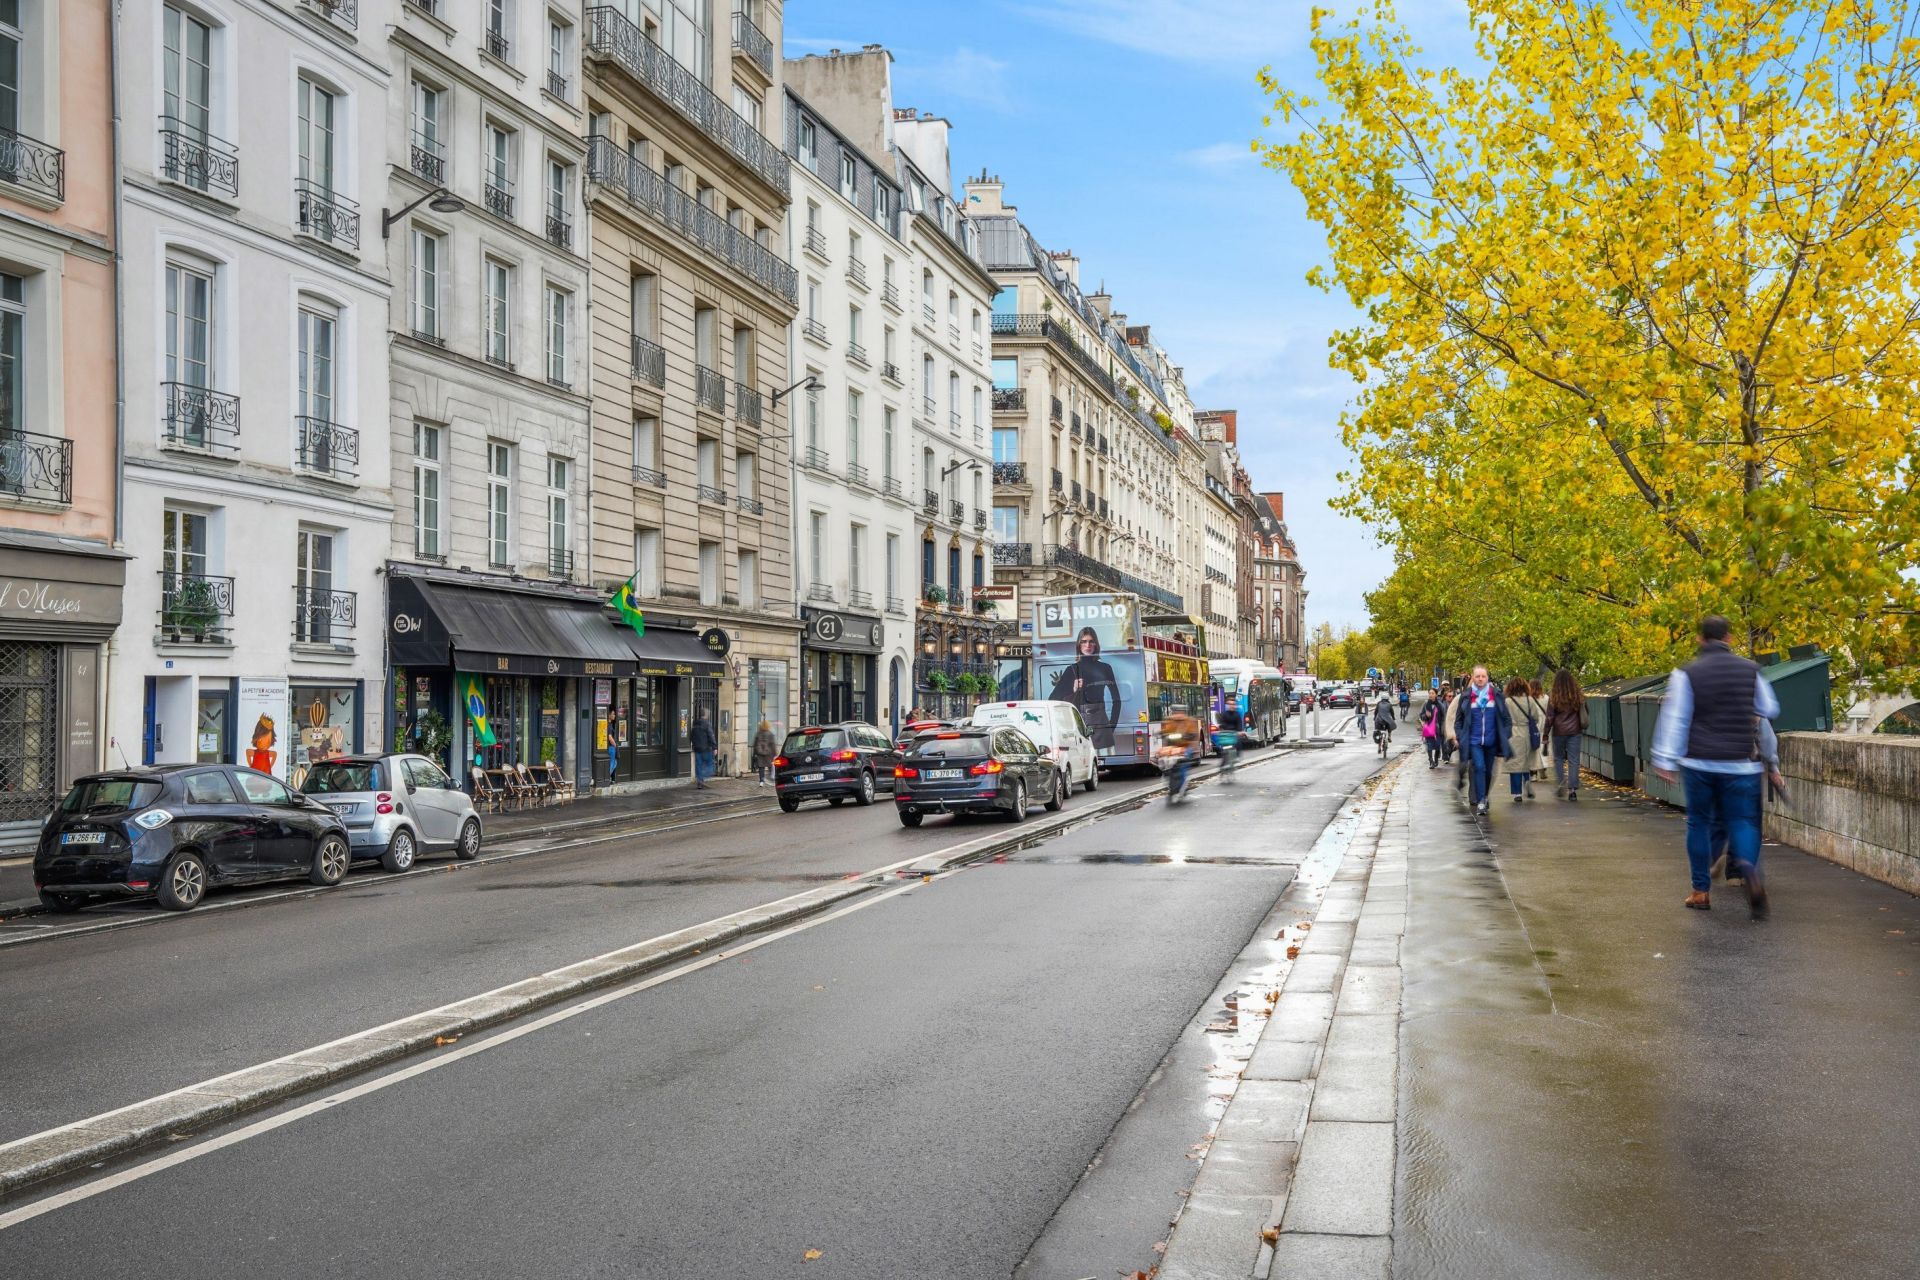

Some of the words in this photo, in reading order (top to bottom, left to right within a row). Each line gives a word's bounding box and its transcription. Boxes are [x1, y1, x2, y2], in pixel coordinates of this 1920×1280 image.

[17, 582, 81, 613] Muses
[1046, 603, 1127, 621] SANDRO
[822, 621, 836, 634] 21
[497, 657, 509, 670] BAR
[584, 662, 614, 675] RESTAURANT
